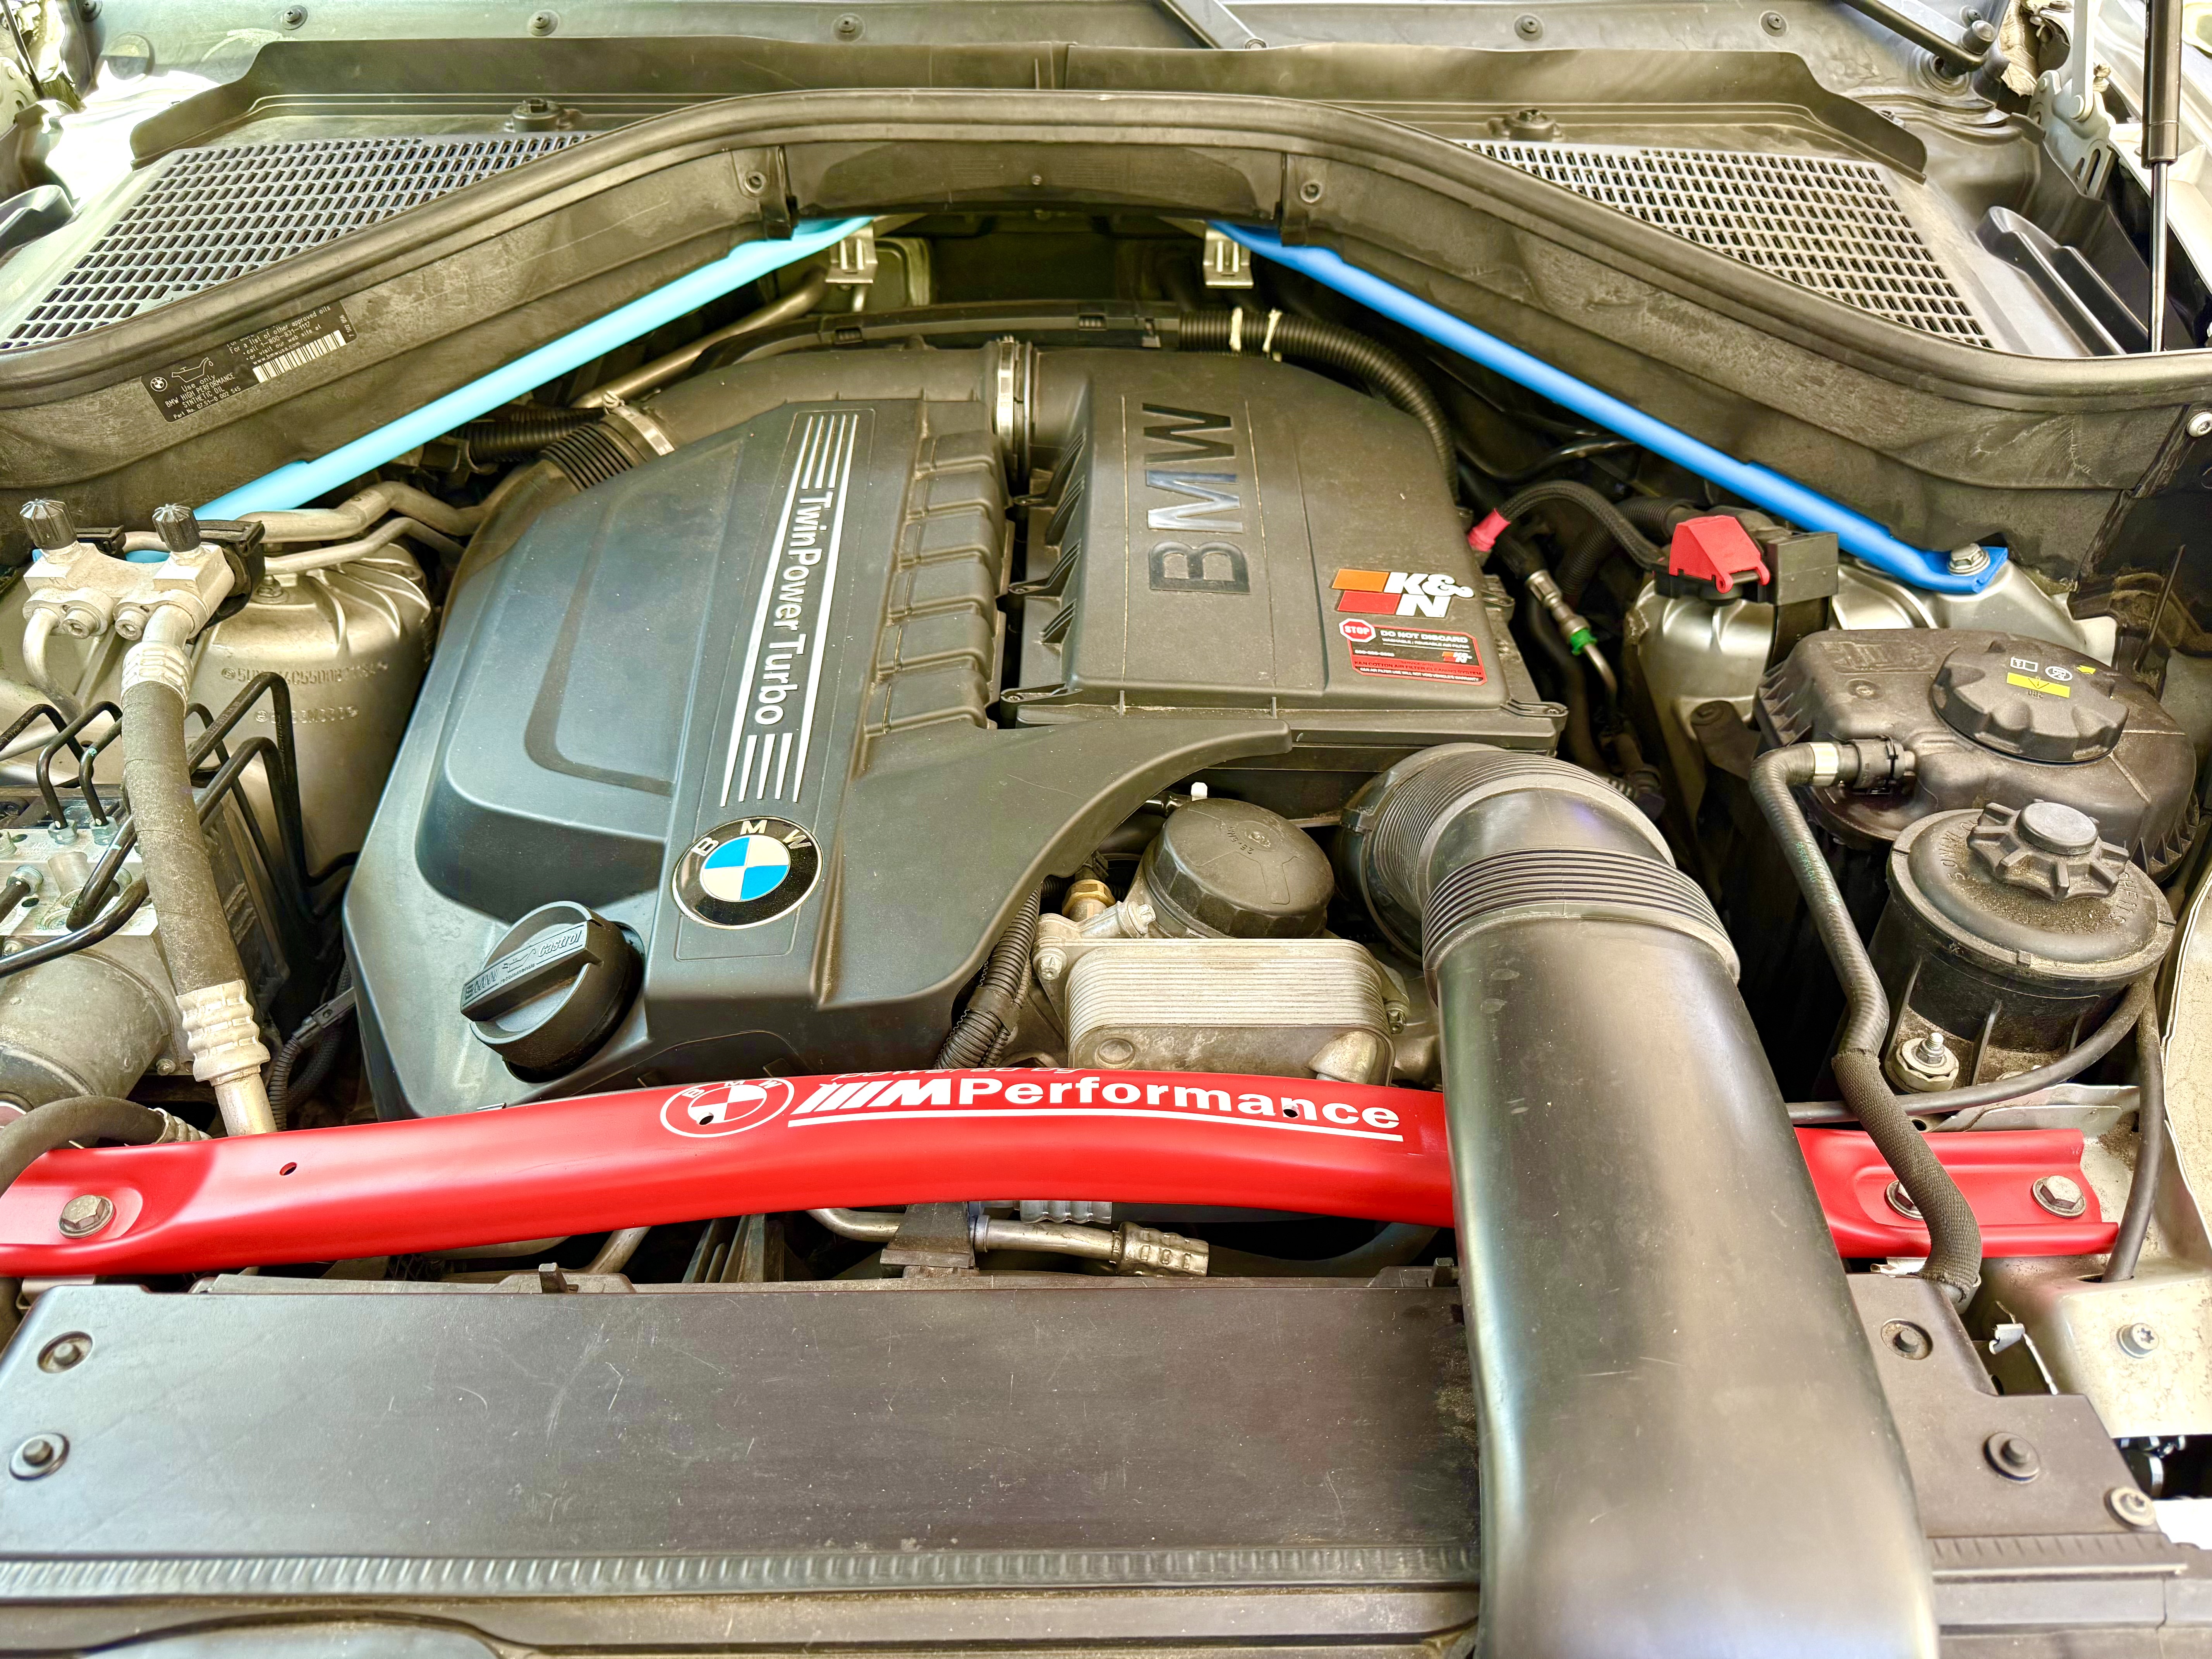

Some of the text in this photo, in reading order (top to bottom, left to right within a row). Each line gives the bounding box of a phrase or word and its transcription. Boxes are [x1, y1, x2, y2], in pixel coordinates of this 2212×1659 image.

[229, 345, 240, 354] For
[249, 335, 261, 345] list
[264, 331, 271, 339] of
[273, 325, 289, 335] other
[291, 310, 317, 327] approved
[319, 306, 331, 314] oils
[259, 346, 273, 355] visit
[301, 328, 313, 337] site
[247, 345, 258, 354] call
[252, 342, 301, 365] www.bmwusa.com
[165, 372, 235, 408] BMW HIGH PERFORMANCE
[181, 374, 216, 392] Use only
[173, 410, 185, 419] Part
[219, 391, 230, 399] 002
[182, 386, 225, 408] SYNTHETIC OIL
[1142, 402, 1250, 594] BMW
[1384, 572, 1474, 618] K&N
[1345, 625, 1370, 635] STOP
[1420, 634, 1468, 643] DISCARD
[754, 634, 807, 725] Turbo
[691, 819, 812, 856] BMW
[465, 930, 582, 1000] BMW recommends Castrol
[682, 1080, 783, 1099] BMW
